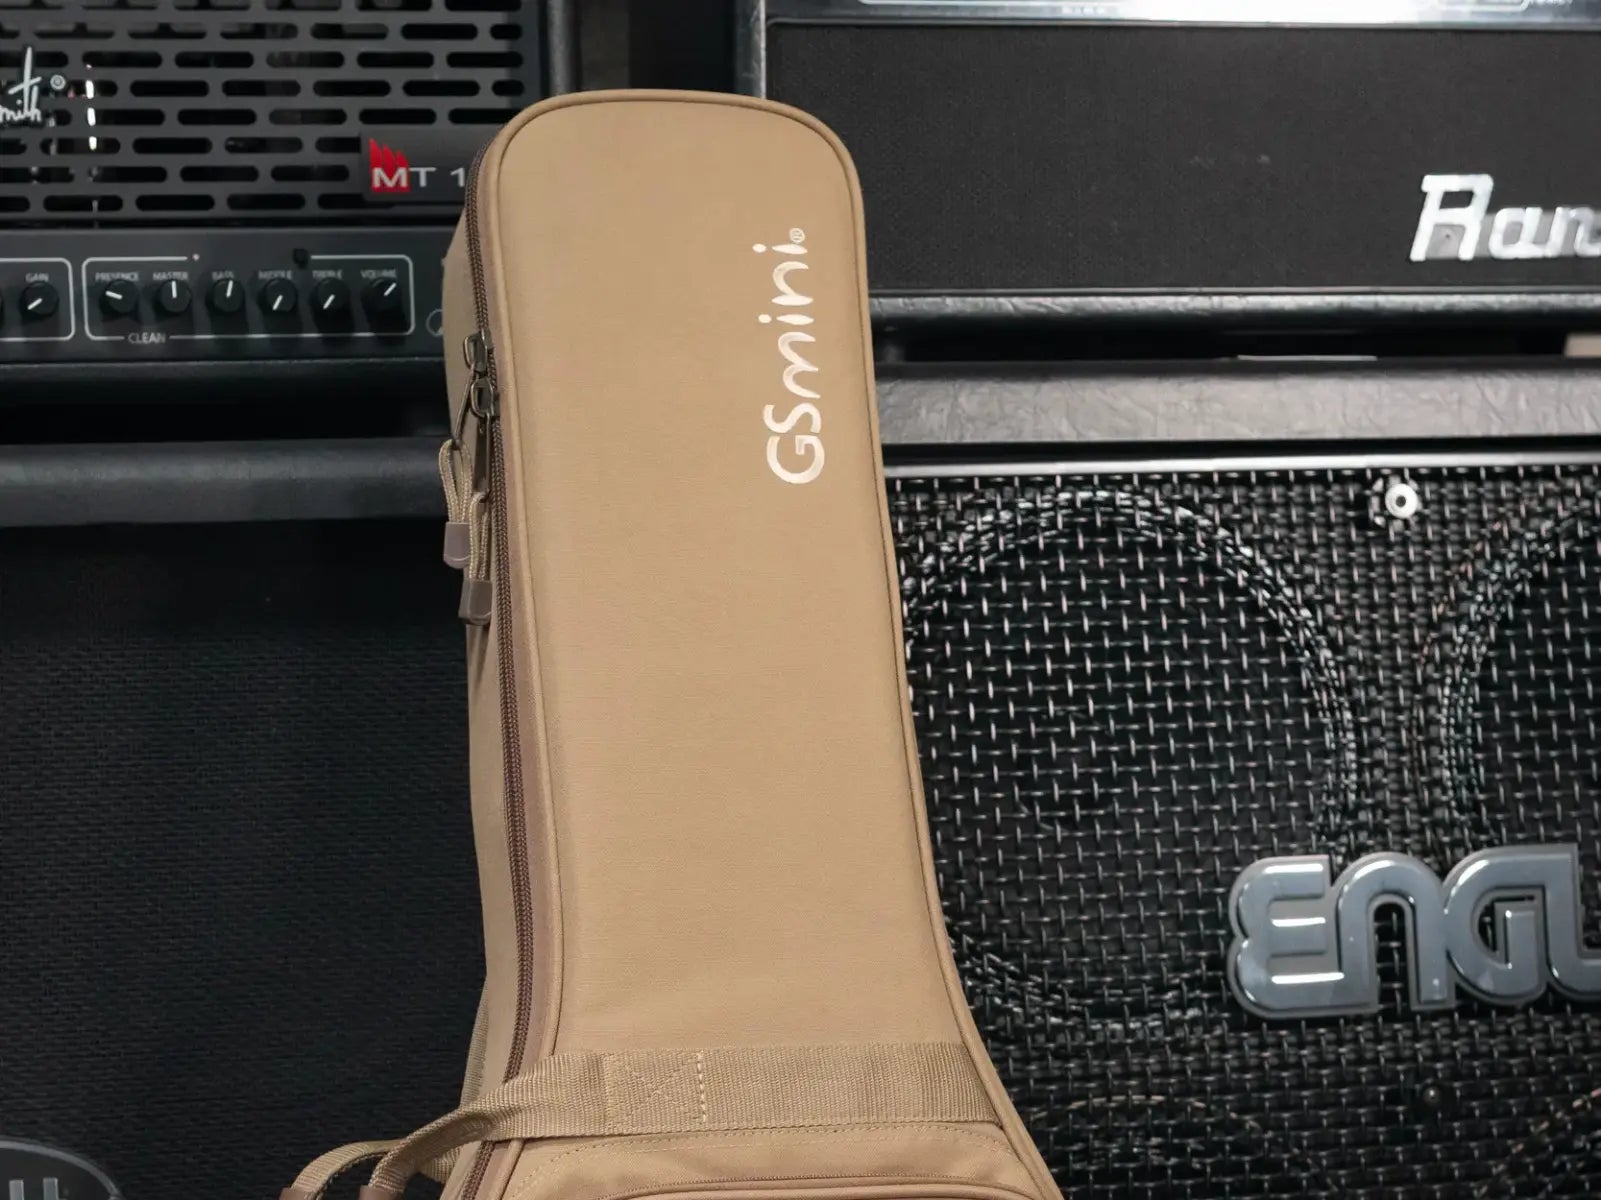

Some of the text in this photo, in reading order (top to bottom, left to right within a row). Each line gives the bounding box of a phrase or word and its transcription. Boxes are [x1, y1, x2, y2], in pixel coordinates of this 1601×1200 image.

[0, 47, 42, 123] mith
[372, 166, 466, 188] MT 1
[1410, 174, 1601, 262] Ran
[25, 272, 49, 282] GAIN
[128, 331, 166, 345] CLEAN
